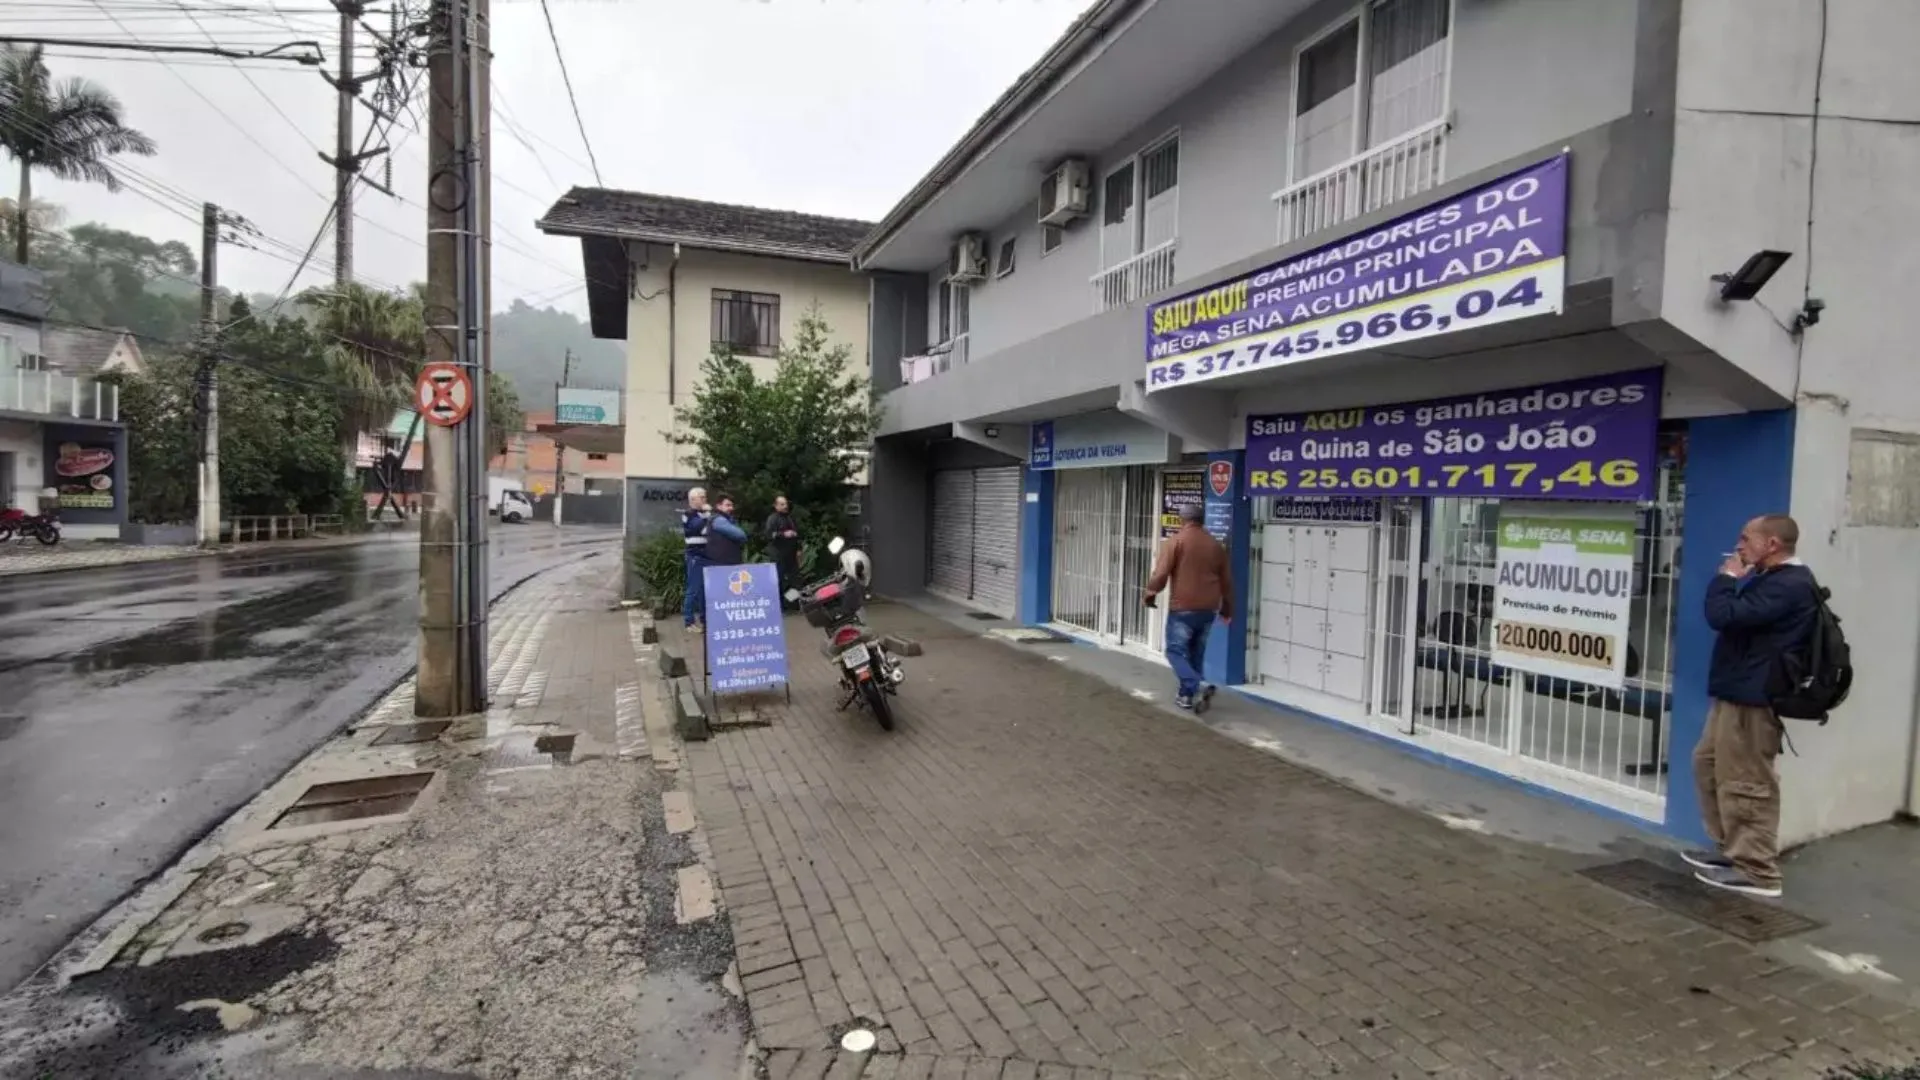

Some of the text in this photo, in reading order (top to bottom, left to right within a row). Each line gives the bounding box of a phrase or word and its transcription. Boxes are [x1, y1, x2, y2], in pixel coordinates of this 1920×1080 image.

[1253, 178, 1539, 287] GANHADORES DO
[1253, 207, 1543, 308] PREMIO PRINCIPAL
[1152, 237, 1544, 357] MEGA SENA ACUMULADA
[1151, 276, 1543, 384] R$ 37.745.966,04
[1153, 299, 1192, 336] SAIU
[1252, 384, 1645, 436] Saiu AQUI os ganhadores
[1088, 446, 1098, 458] DA
[1101, 444, 1126, 457] VELHA
[1268, 420, 1597, 462] da Quina de São João
[1250, 459, 1640, 492] R$ 25.601.717,46
[1276, 505, 1318, 518] GUARDA
[1524, 525, 1627, 546] MEGA SENA
[1499, 561, 1630, 598] ACUMULOU!
[725, 608, 767, 621] VELHA
[1553, 604, 1568, 614] de
